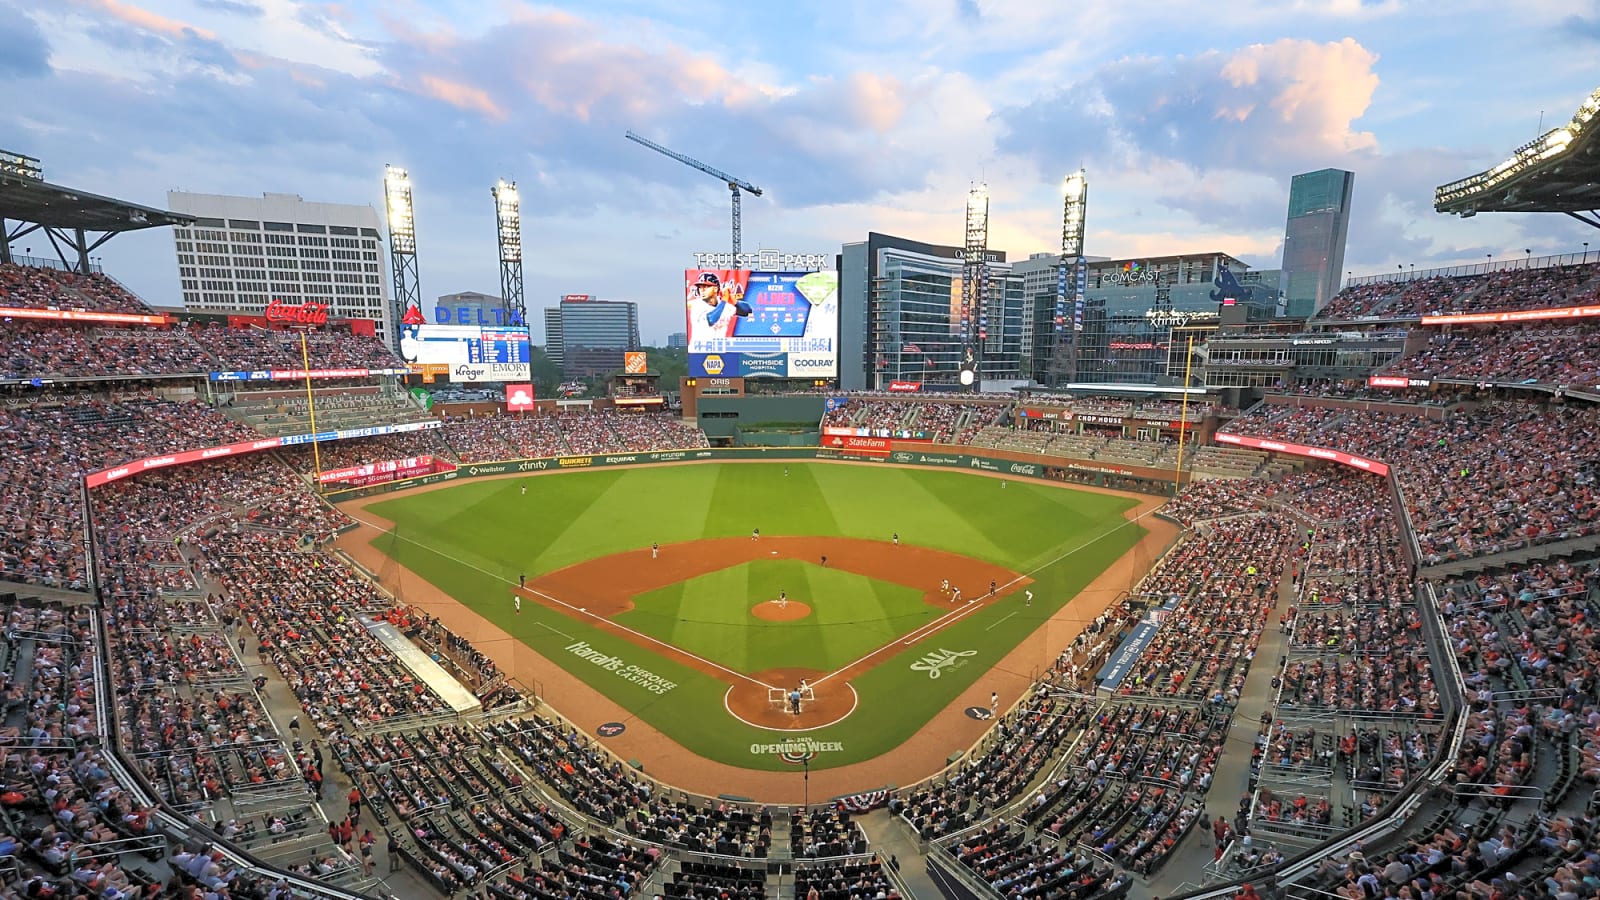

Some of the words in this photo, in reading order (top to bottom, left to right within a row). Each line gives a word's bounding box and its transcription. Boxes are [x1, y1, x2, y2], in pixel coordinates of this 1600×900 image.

[694, 253, 755, 267] TRUIST
[784, 254, 829, 268] PARK
[1102, 270, 1161, 283] COMCAST
[266, 299, 328, 324] Coca-Cola
[434, 306, 524, 325] DELTA
[1150, 316, 1189, 329] xfinity
[492, 363, 528, 372] EMORY
[706, 360, 722, 369] NAPA
[794, 359, 834, 367] COOLRAY
[1098, 416, 1122, 424] HOUSE
[848, 438, 867, 447] State
[867, 439, 885, 448] Farm
[518, 461, 548, 472] xfinity
[564, 641, 624, 671] Harrah's
[615, 668, 668, 695] CASINOS
[626, 664, 678, 691] CHEROKEE
[750, 743, 807, 754] OPENING
[807, 741, 844, 752] WEEK
